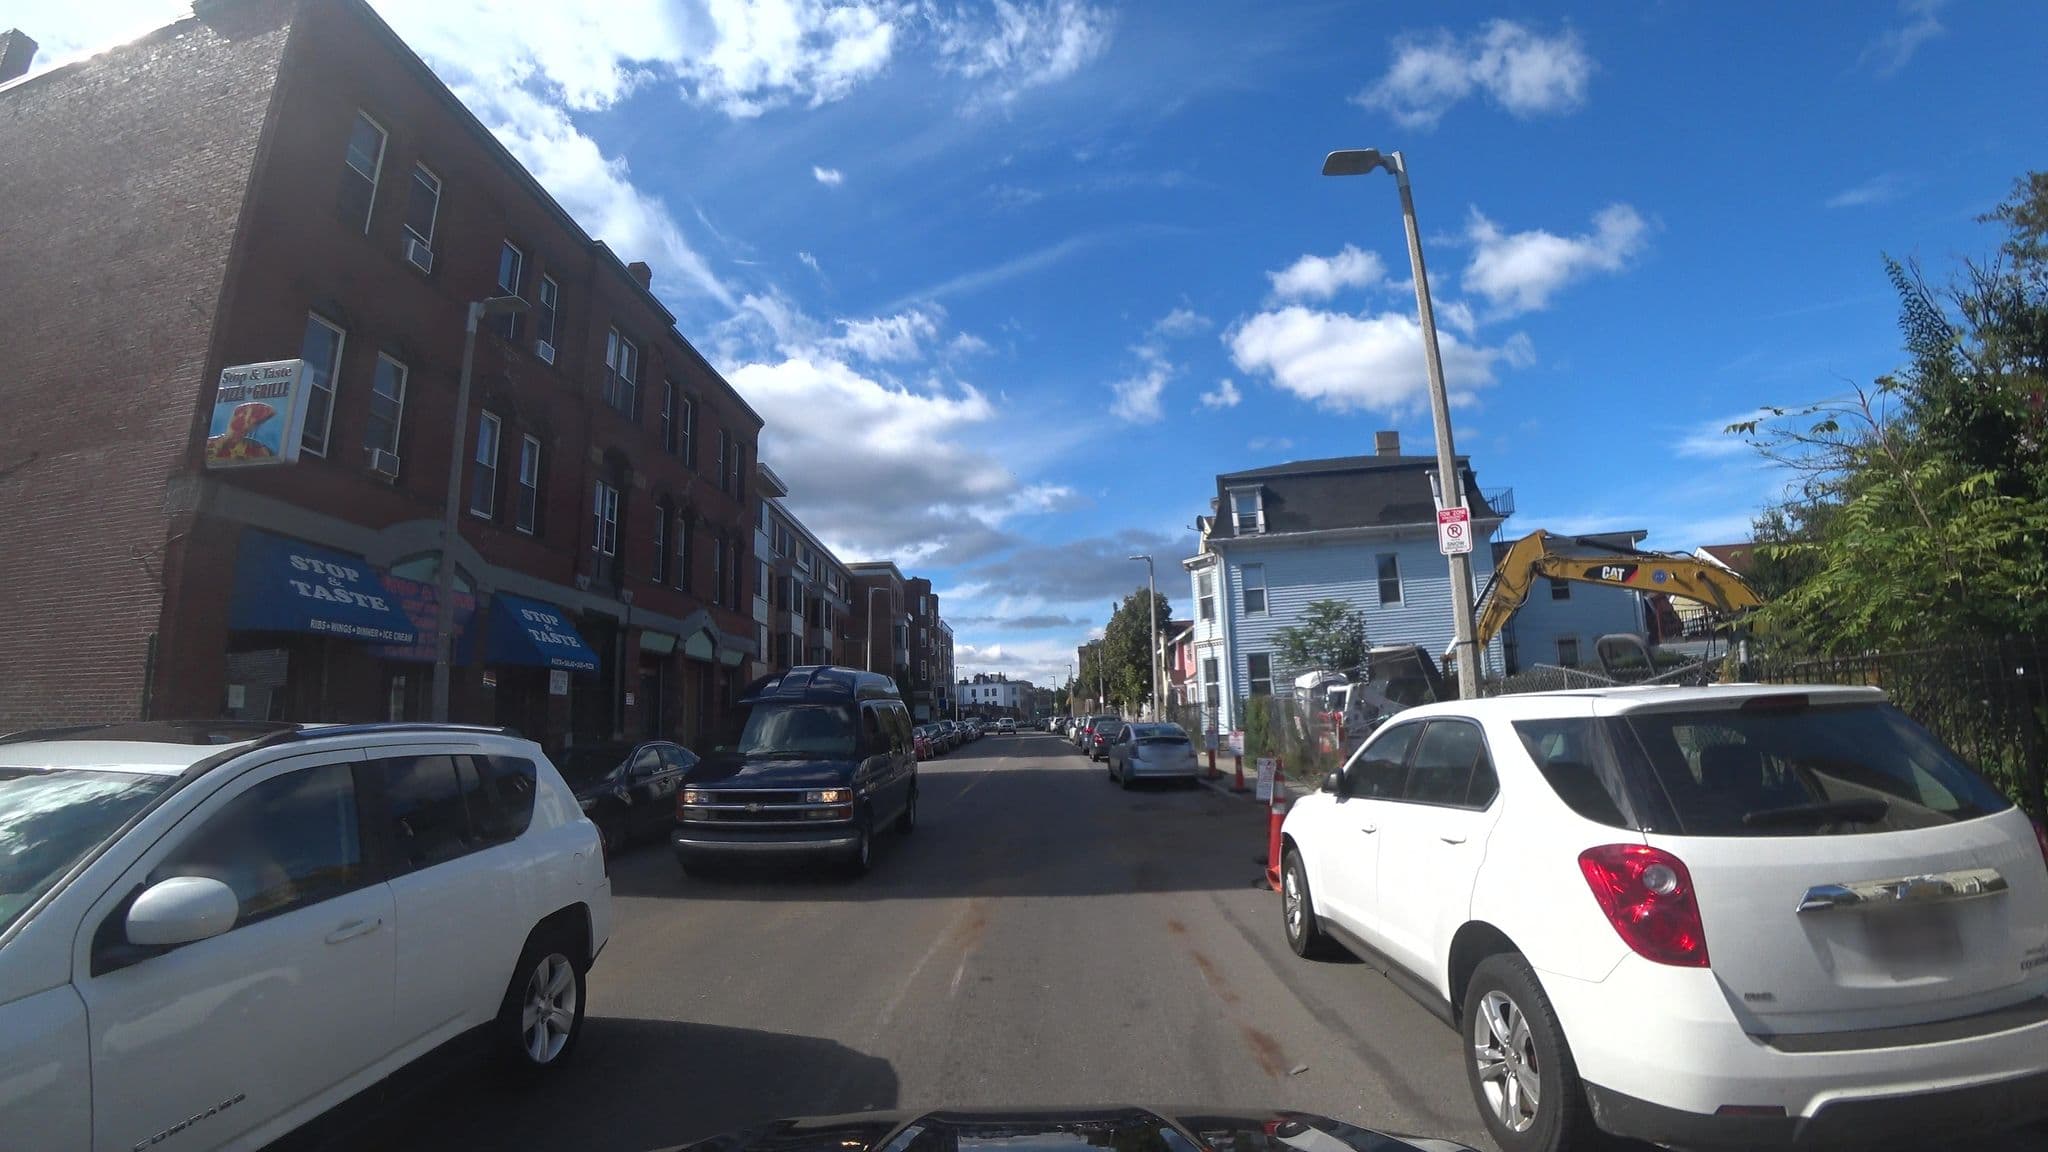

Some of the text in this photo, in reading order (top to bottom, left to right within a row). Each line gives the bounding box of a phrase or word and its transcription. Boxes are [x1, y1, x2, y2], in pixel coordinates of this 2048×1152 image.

[250, 368, 261, 380] &
[263, 367, 292, 379] Taste
[289, 554, 360, 583] STOP
[1601, 566, 1625, 582] CAT
[327, 577, 344, 588] &
[288, 578, 391, 612] TASTE
[520, 608, 560, 626] STOP
[330, 621, 352, 634] WINGS
[393, 631, 414, 643] CREAM
[527, 628, 582, 648] TASTE
